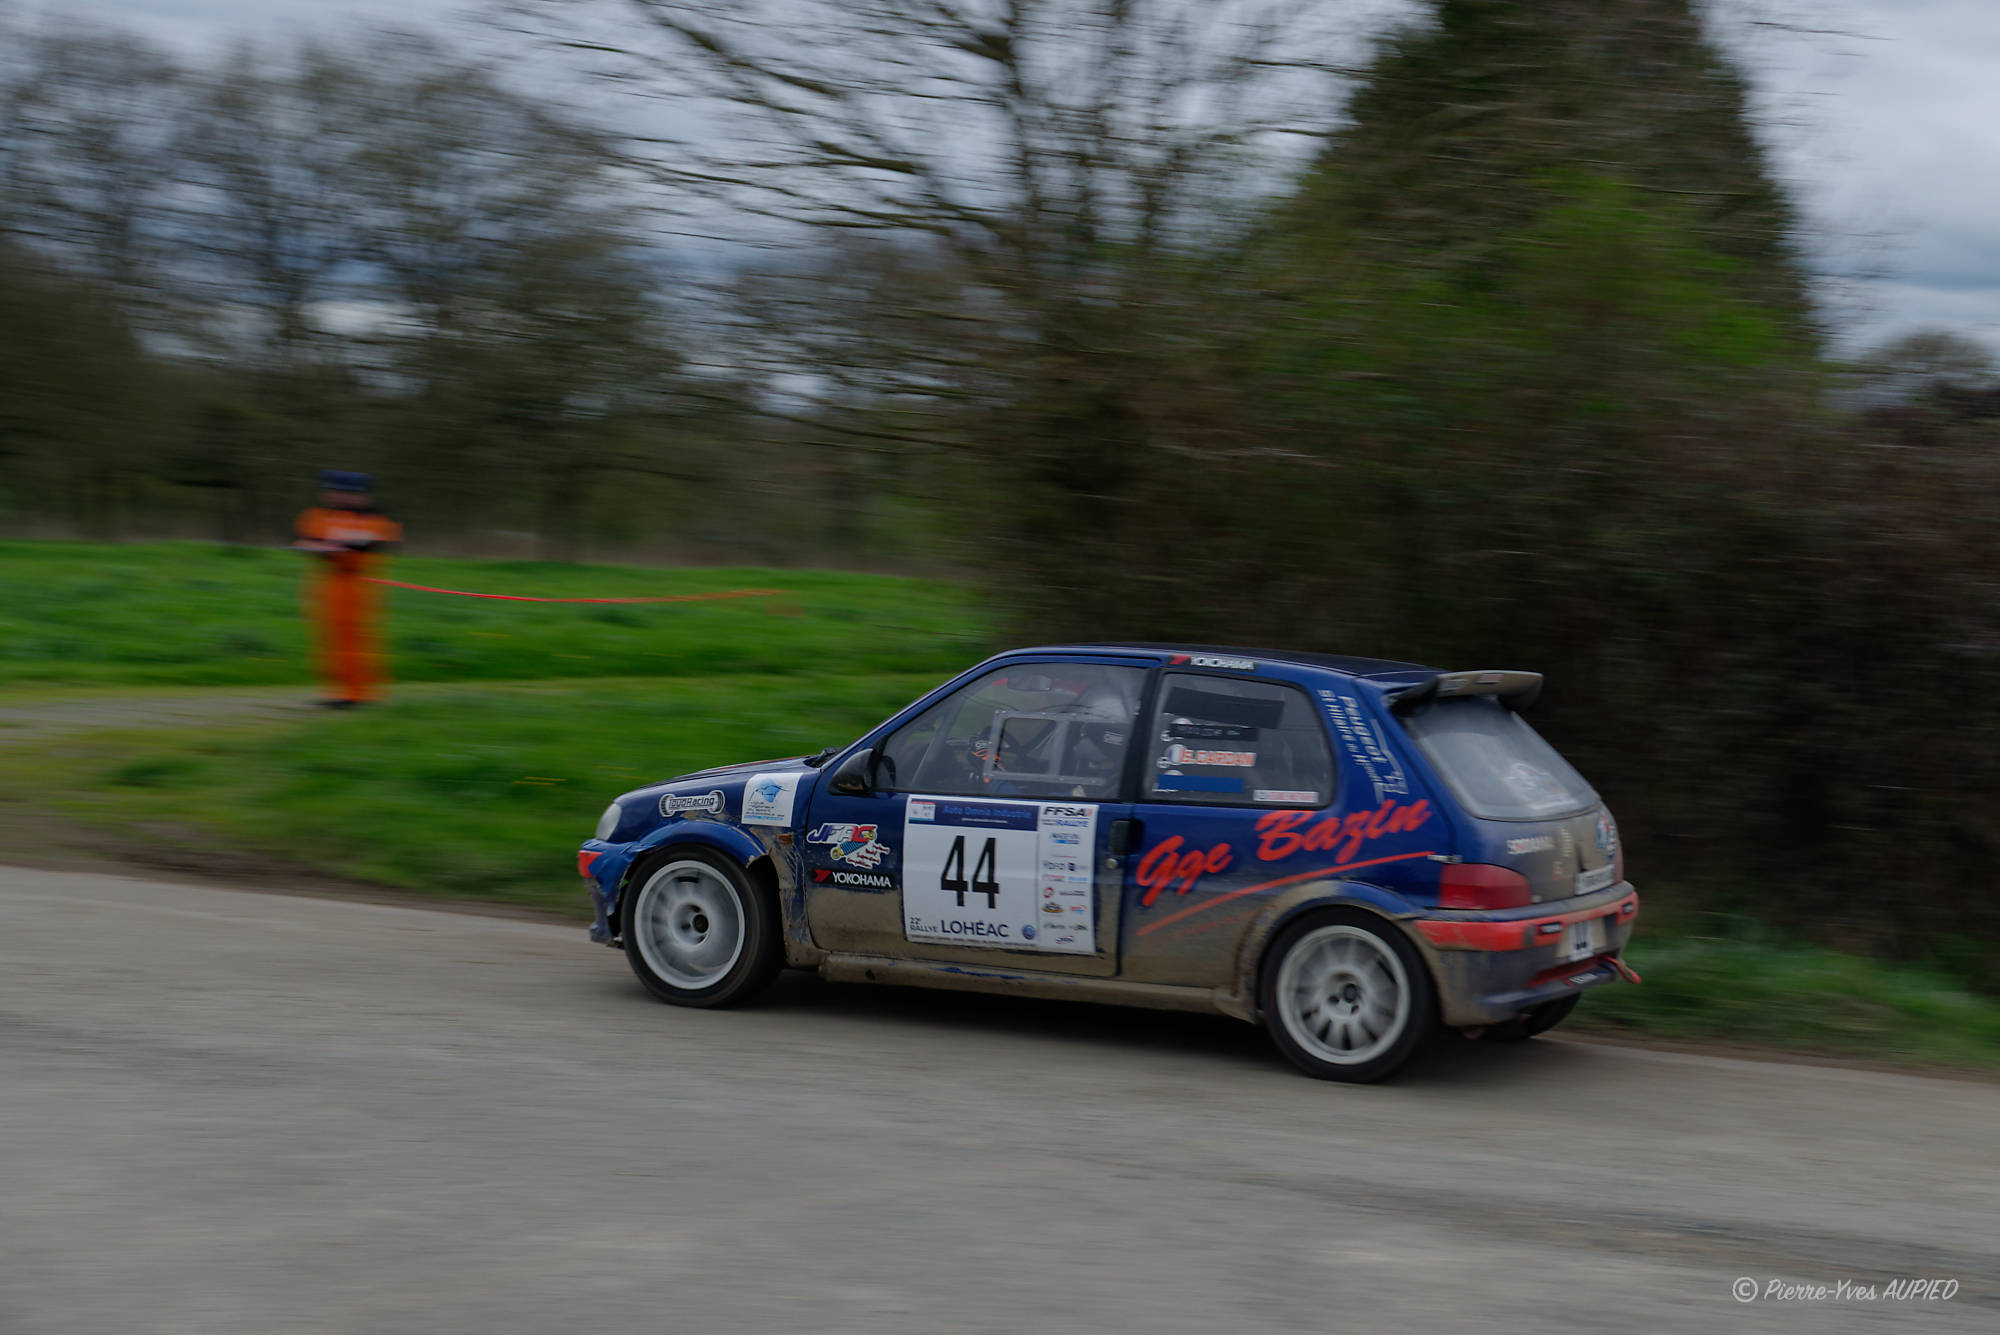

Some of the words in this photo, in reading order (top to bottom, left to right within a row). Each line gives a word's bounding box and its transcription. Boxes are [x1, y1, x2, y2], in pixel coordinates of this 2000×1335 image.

[1043, 806, 1086, 817] FFSA
[1254, 799, 1433, 864] Bazin
[832, 871, 891, 888] YOKOHAMA
[941, 835, 999, 909] 44
[941, 919, 1009, 938] LOHÉAC
